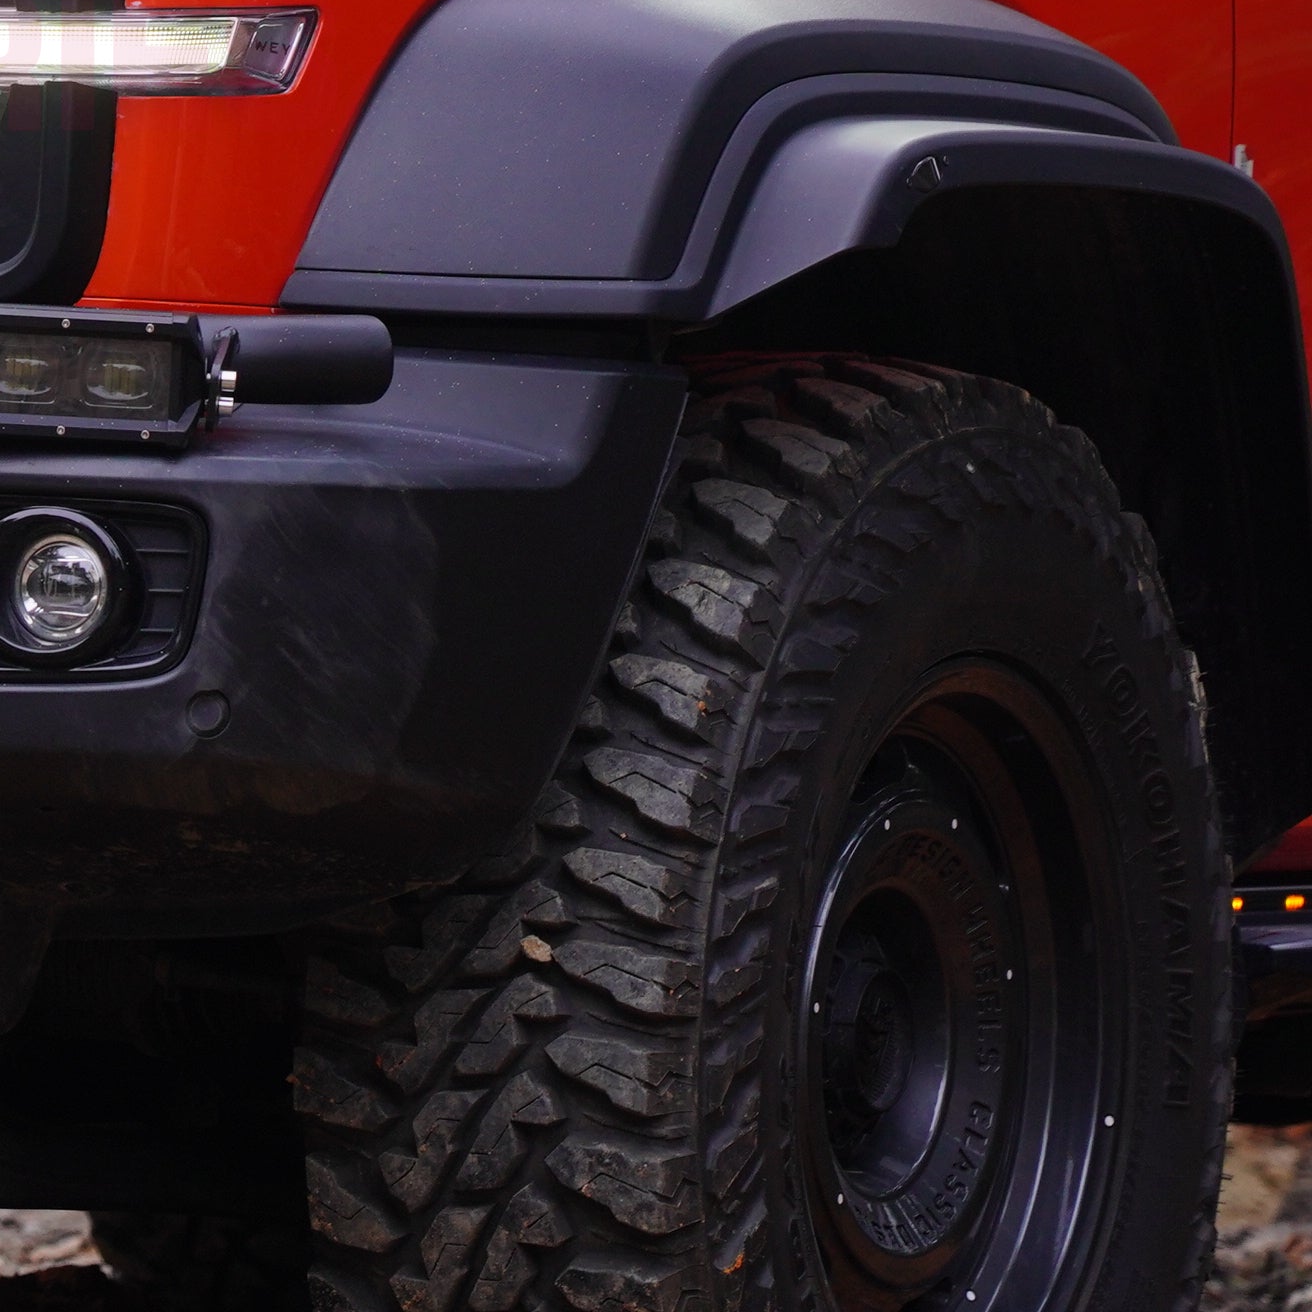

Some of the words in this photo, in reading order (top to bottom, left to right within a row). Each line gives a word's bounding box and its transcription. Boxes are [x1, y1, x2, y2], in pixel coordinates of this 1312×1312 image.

[255, 40, 292, 56] WEY
[1082, 620, 1194, 1111] YOKOHAMA
[966, 904, 1003, 1073] WHEELS
[907, 1099, 995, 1245] CLASSIC
